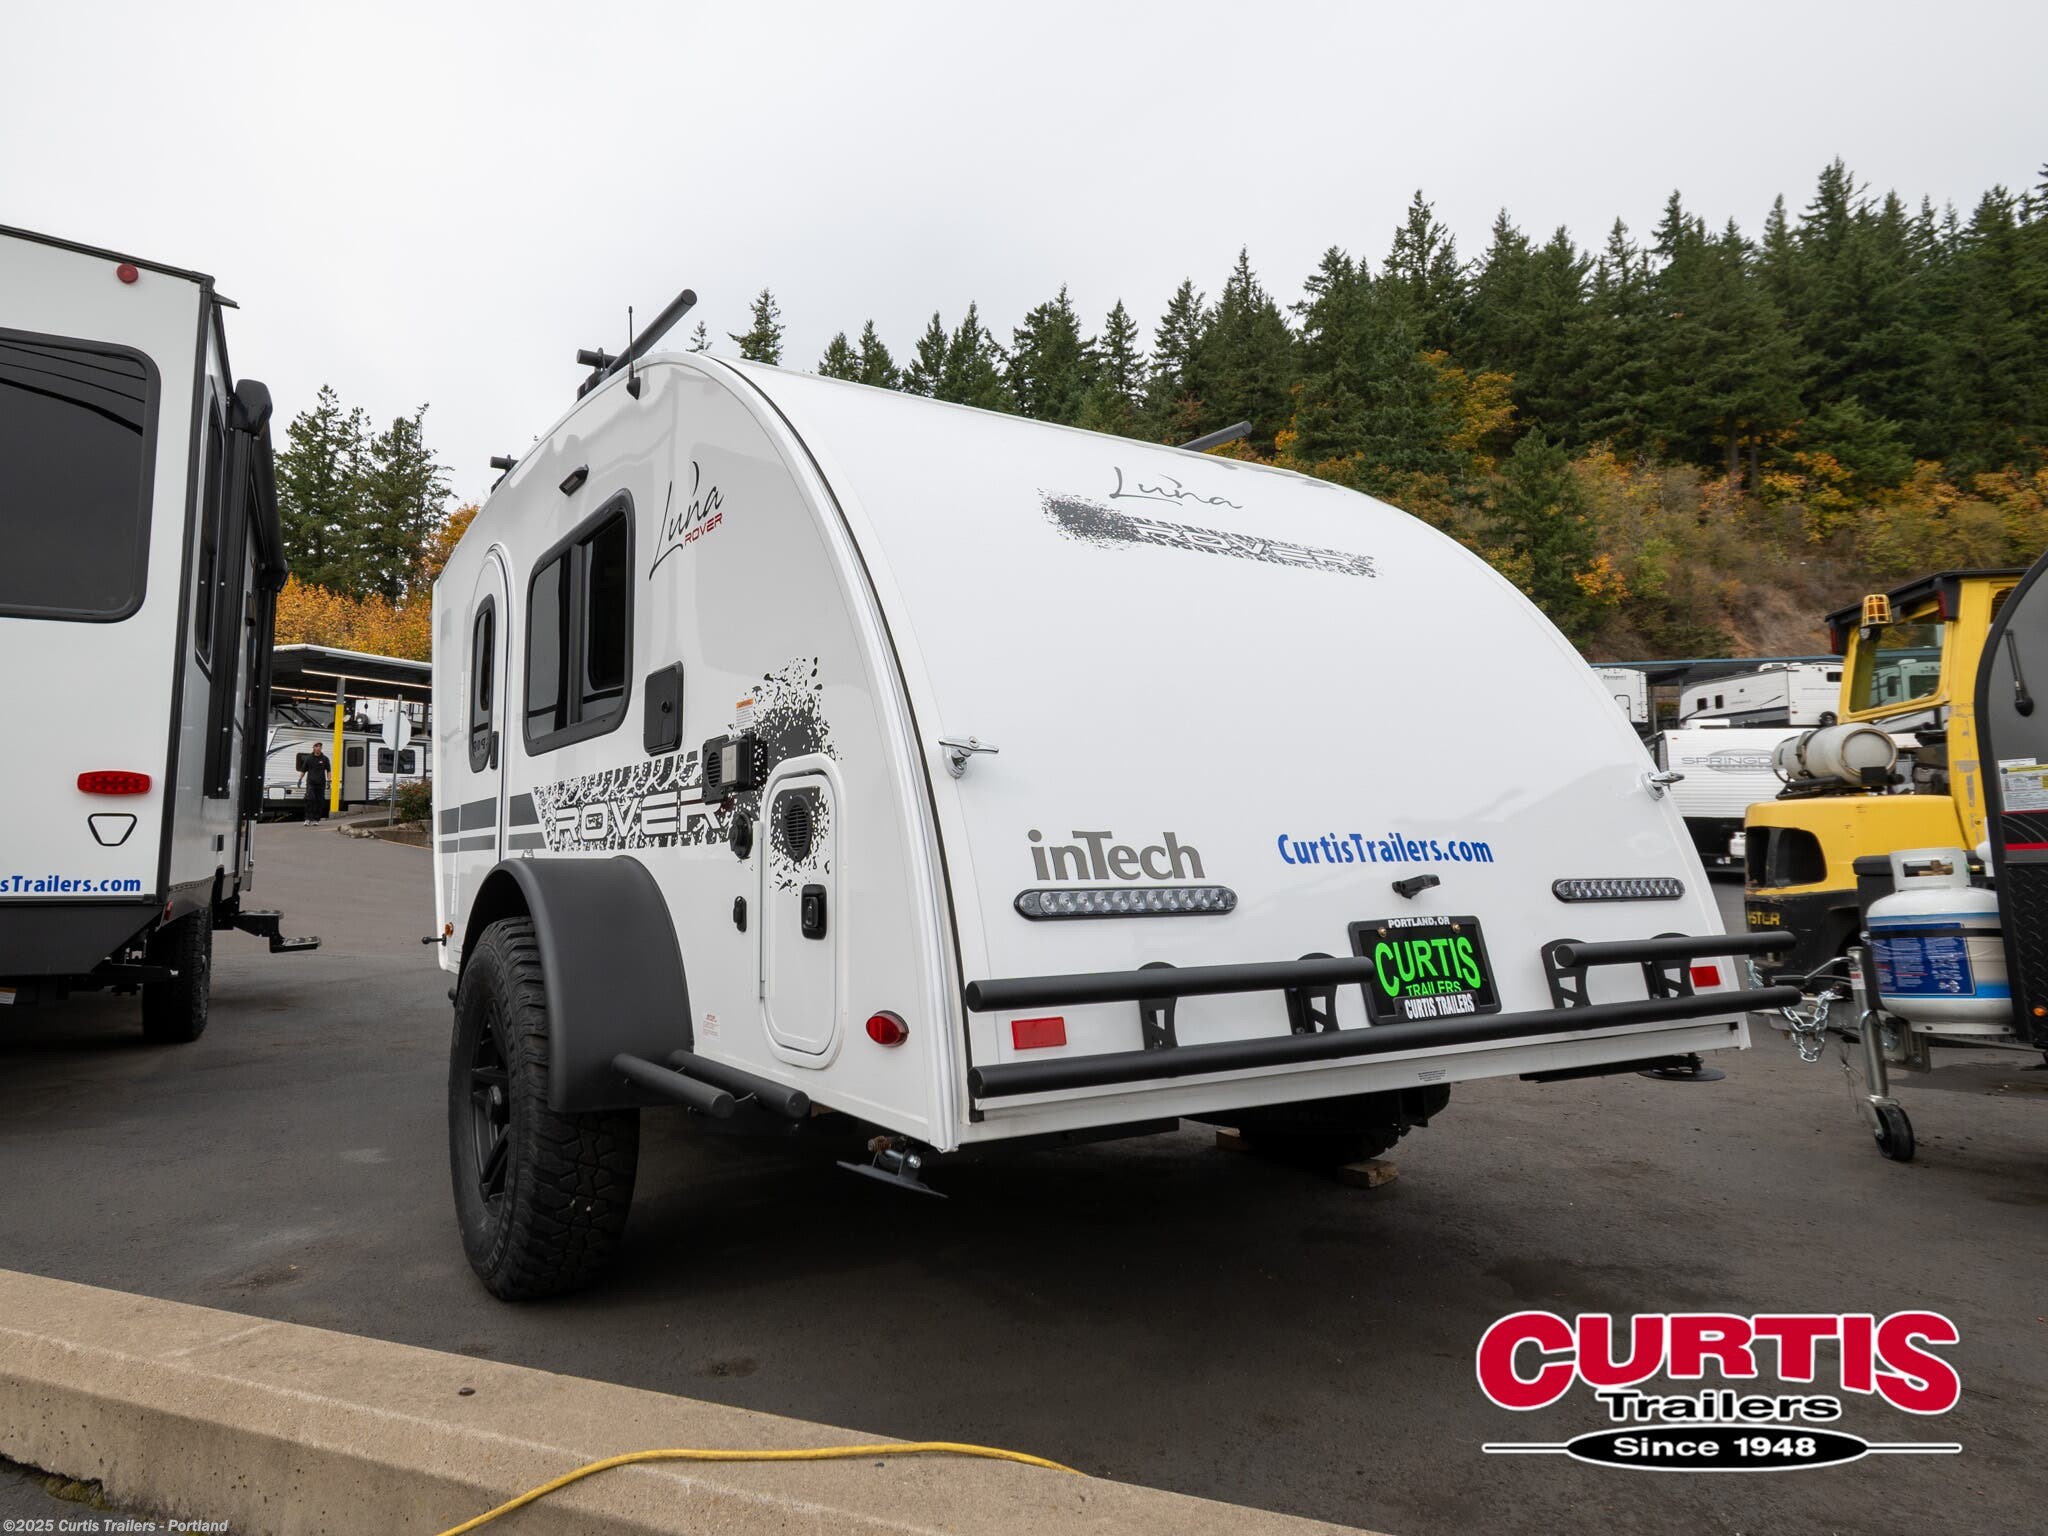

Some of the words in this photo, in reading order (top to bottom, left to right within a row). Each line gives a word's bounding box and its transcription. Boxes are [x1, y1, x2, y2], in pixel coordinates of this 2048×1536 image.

[1109, 466, 1243, 509] Luna
[648, 461, 724, 581] Luna
[684, 512, 723, 546] ROVER
[555, 787, 721, 842] ROVER
[1028, 829, 1206, 881] inTech
[1278, 833, 1494, 864] CurtisTrailers.com
[0, 875, 141, 893] sTrailers.com
[1375, 936, 1481, 997] CURTIS
[1404, 998, 1437, 1019] CURTIS
[1436, 993, 1475, 1014] TRAILERS
[1406, 980, 1462, 996] TRAILERS
